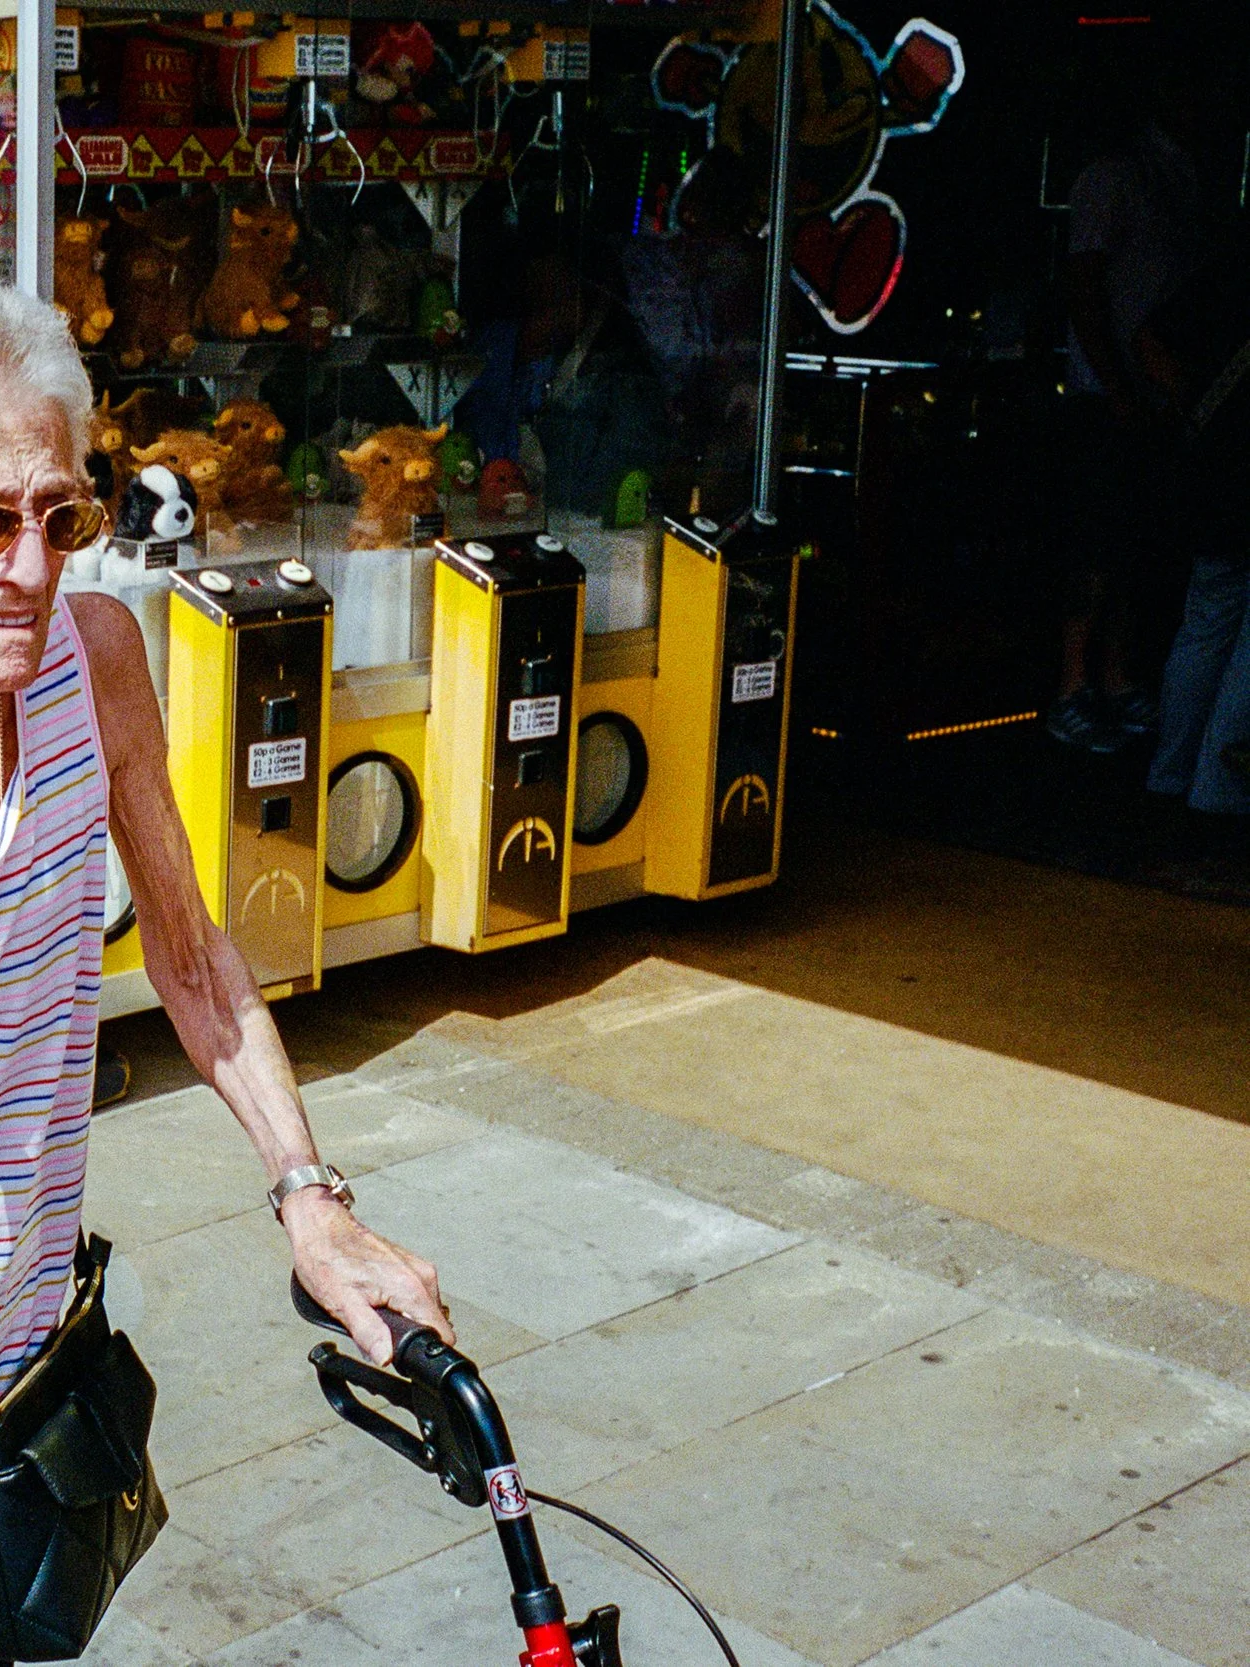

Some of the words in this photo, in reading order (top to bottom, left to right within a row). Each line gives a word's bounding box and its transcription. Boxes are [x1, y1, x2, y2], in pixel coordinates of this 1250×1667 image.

[254, 748, 267, 757] 50p
[276, 744, 301, 753] Game
[274, 755, 300, 764] Games
[274, 764, 300, 773] Games
